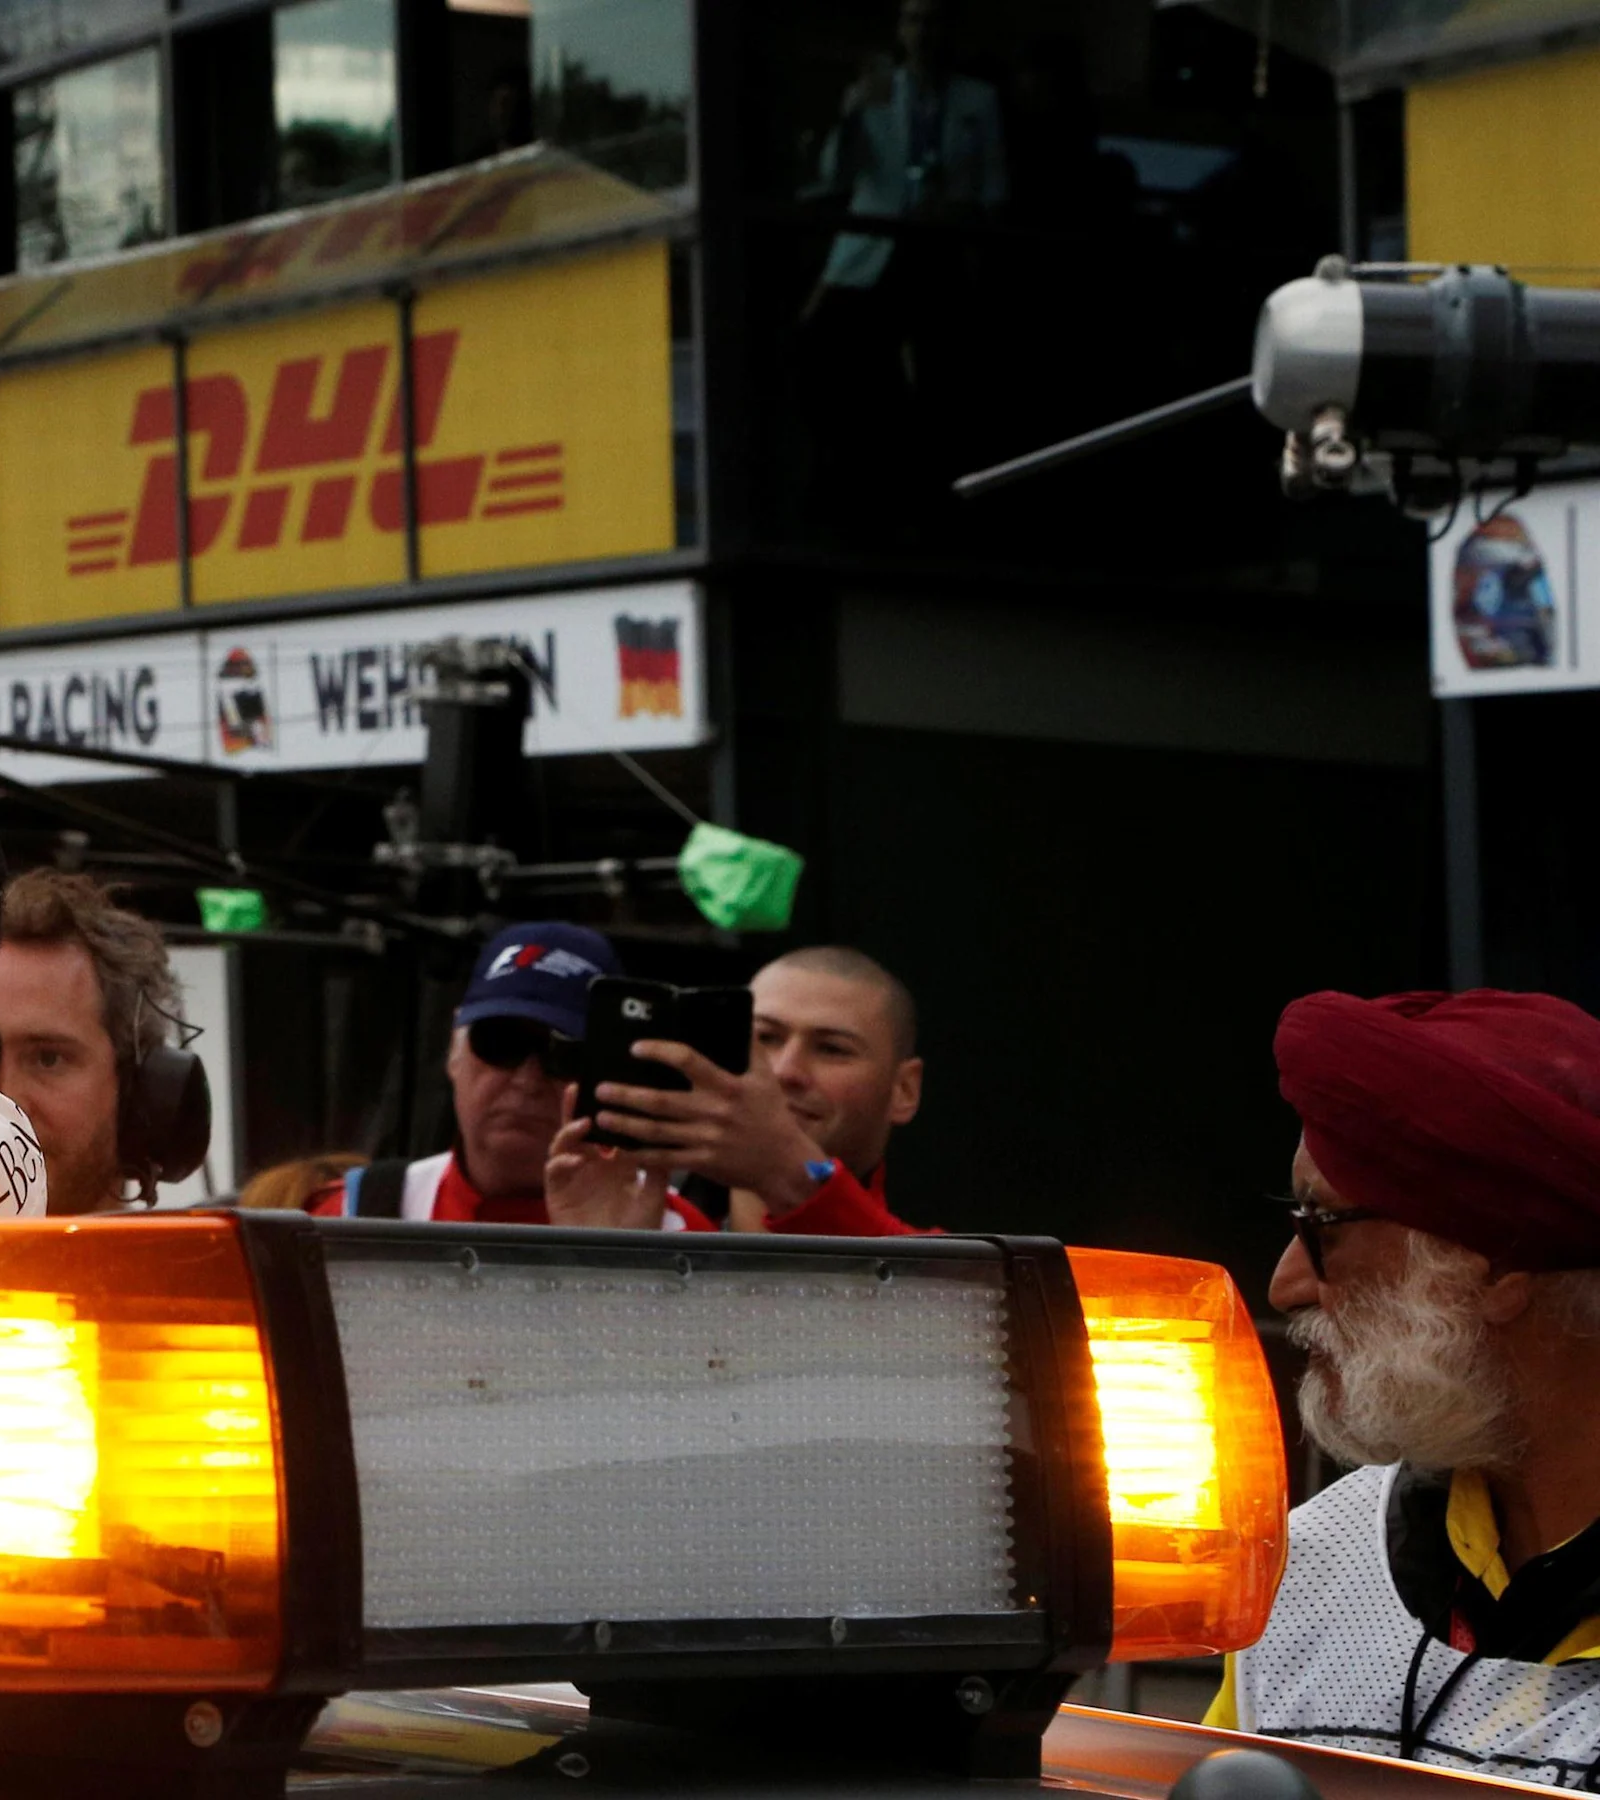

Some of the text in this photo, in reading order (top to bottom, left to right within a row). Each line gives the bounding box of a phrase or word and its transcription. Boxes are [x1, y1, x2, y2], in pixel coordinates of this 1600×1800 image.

[128, 328, 486, 567] DHL
[10, 665, 159, 747] RACING
[310, 630, 557, 733] WEHN
